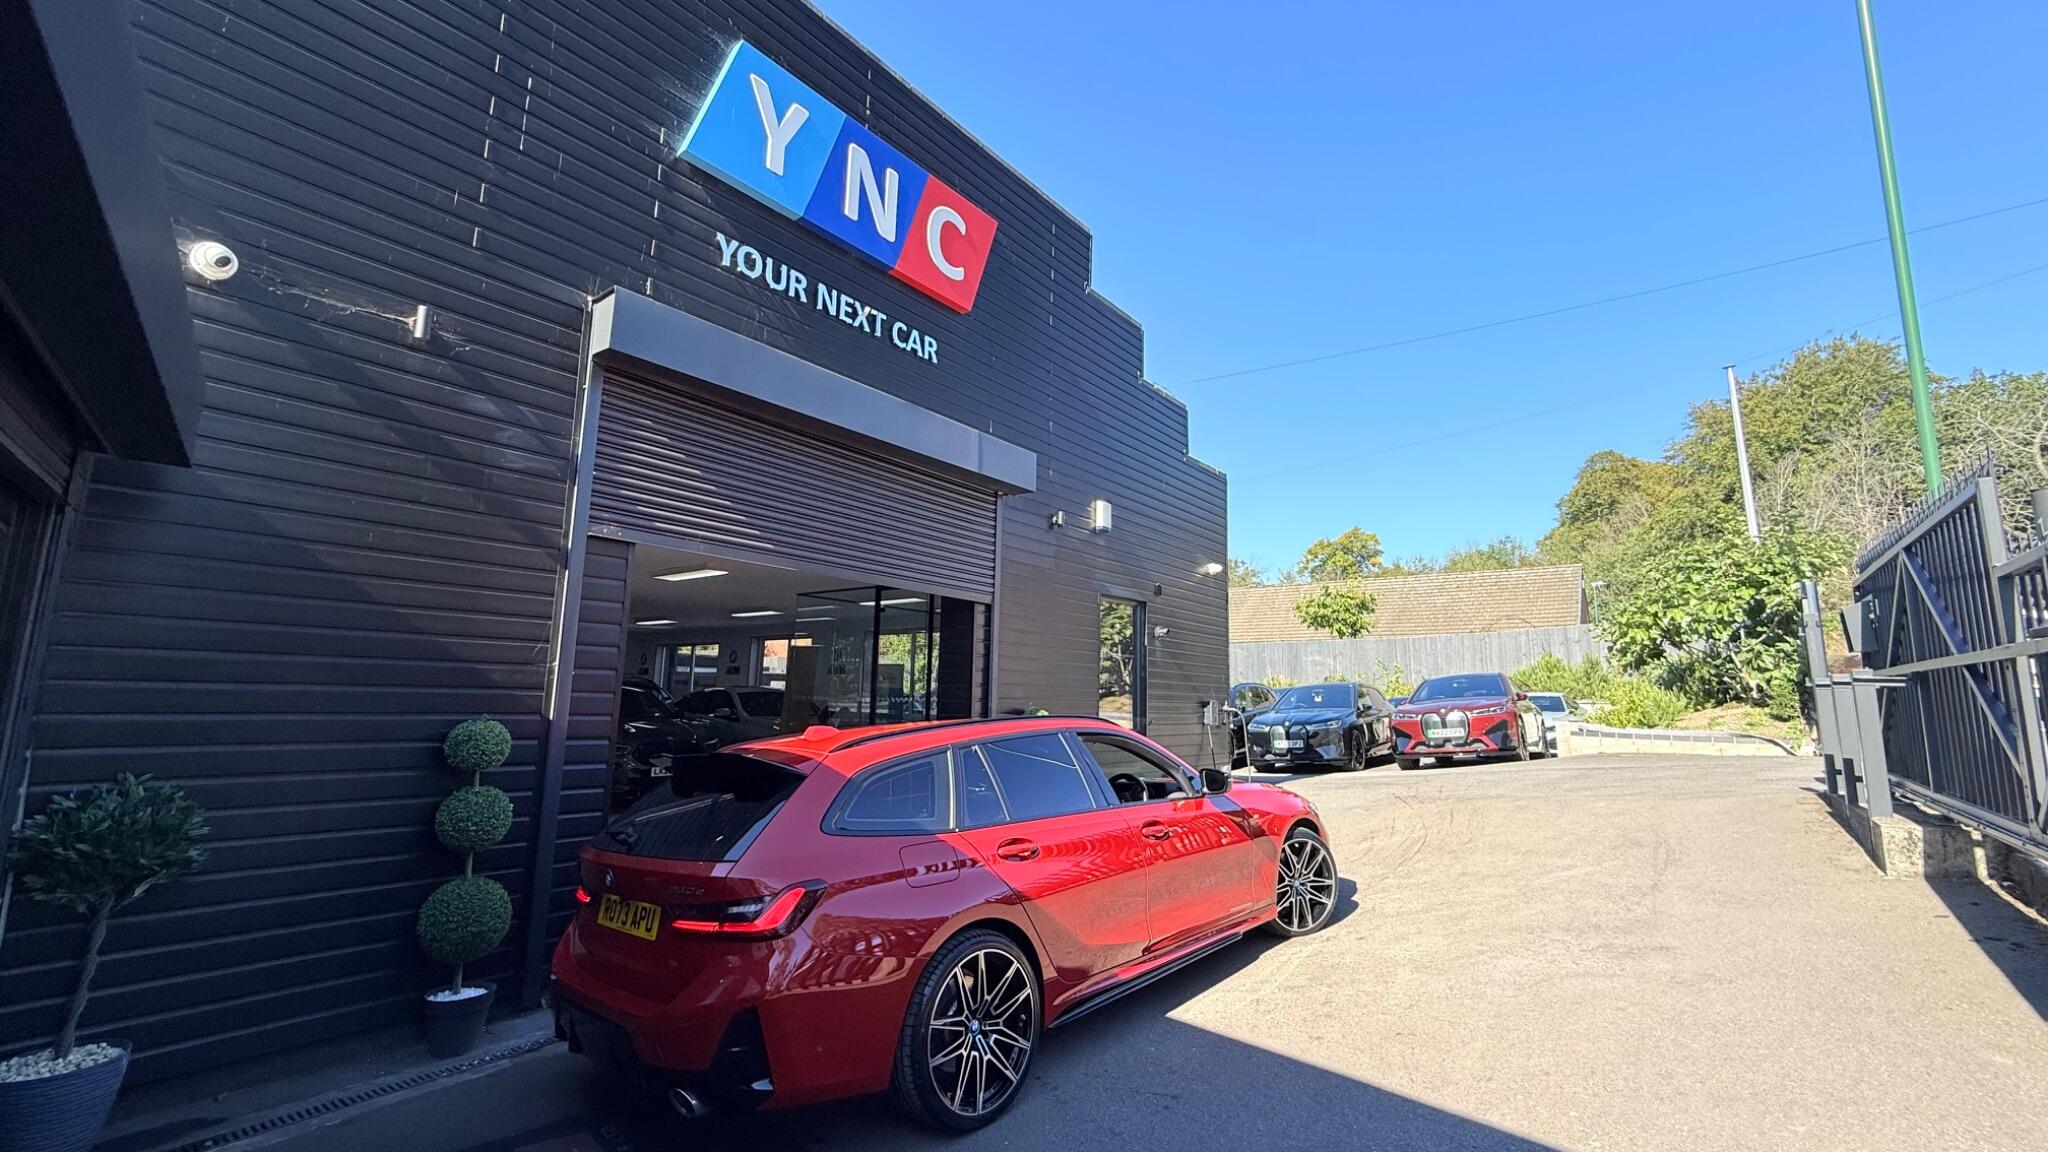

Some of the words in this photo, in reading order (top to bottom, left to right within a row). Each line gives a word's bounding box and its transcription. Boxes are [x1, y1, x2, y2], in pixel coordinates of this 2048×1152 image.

[750, 73, 967, 281] YNC
[717, 232, 808, 304] YOUR
[816, 282, 887, 338] NEXT
[892, 321, 938, 364] CAR
[630, 904, 657, 933] APU
